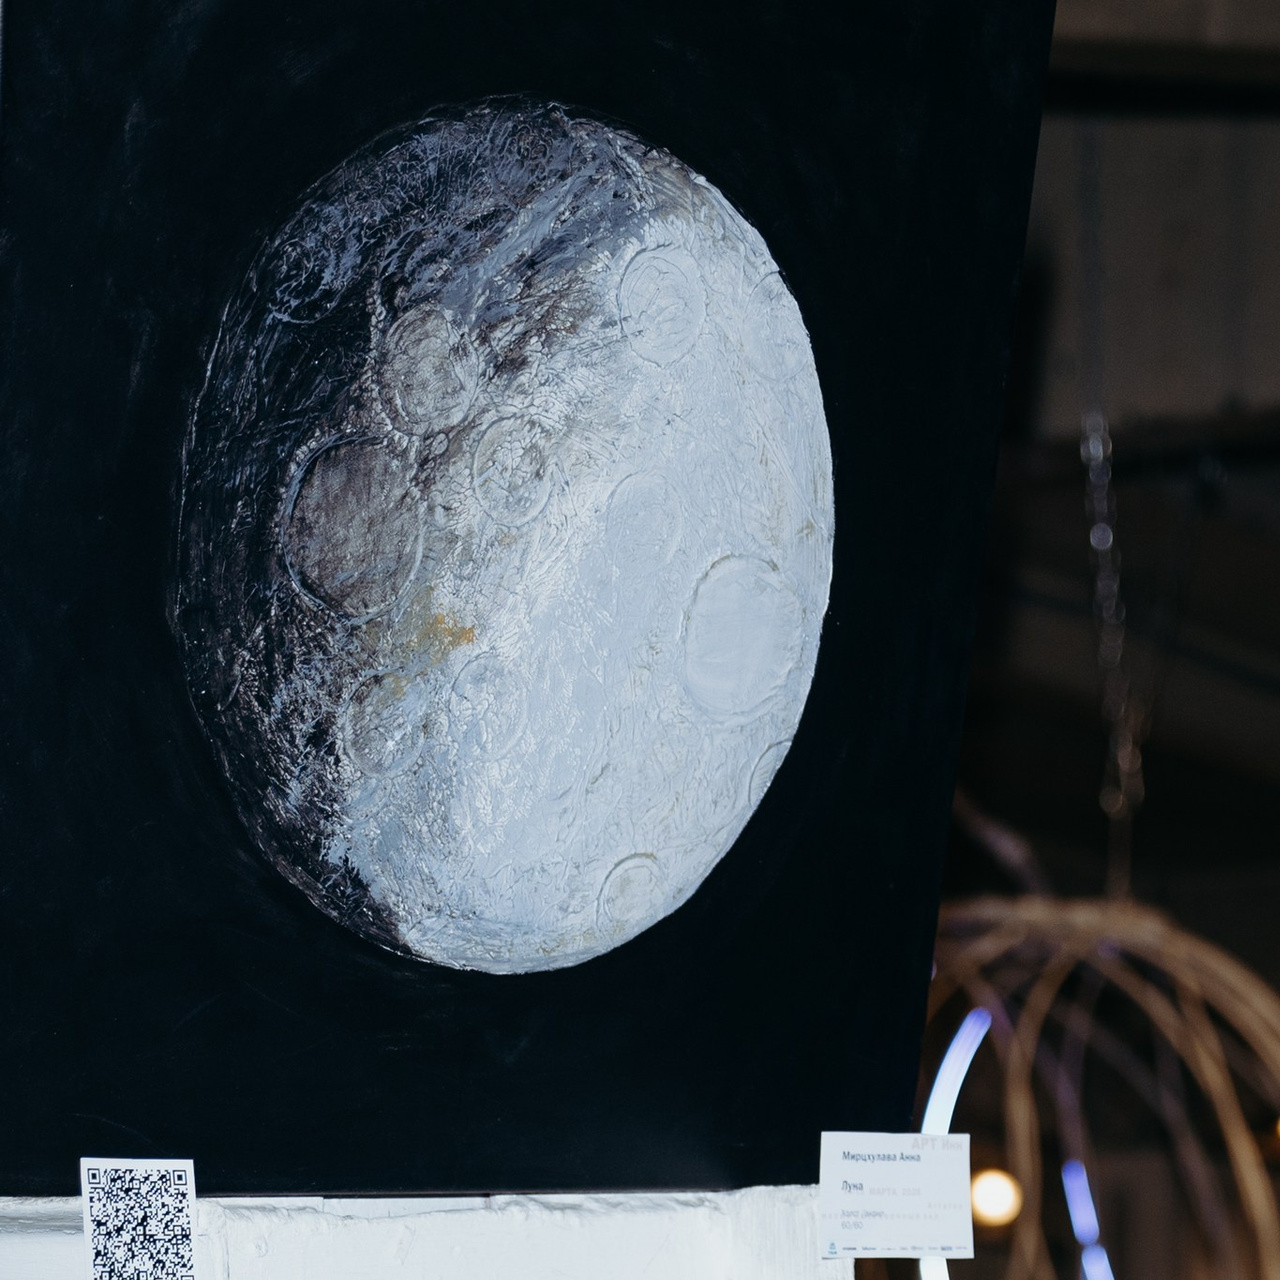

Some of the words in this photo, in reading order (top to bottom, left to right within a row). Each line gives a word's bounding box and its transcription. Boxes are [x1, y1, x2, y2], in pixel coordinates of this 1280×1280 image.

[912, 1138, 938, 1150] АРТ
[842, 1151, 898, 1163] Мирцхулава
[899, 1152, 921, 1162] Анна
[841, 1180, 864, 1193] Луна
